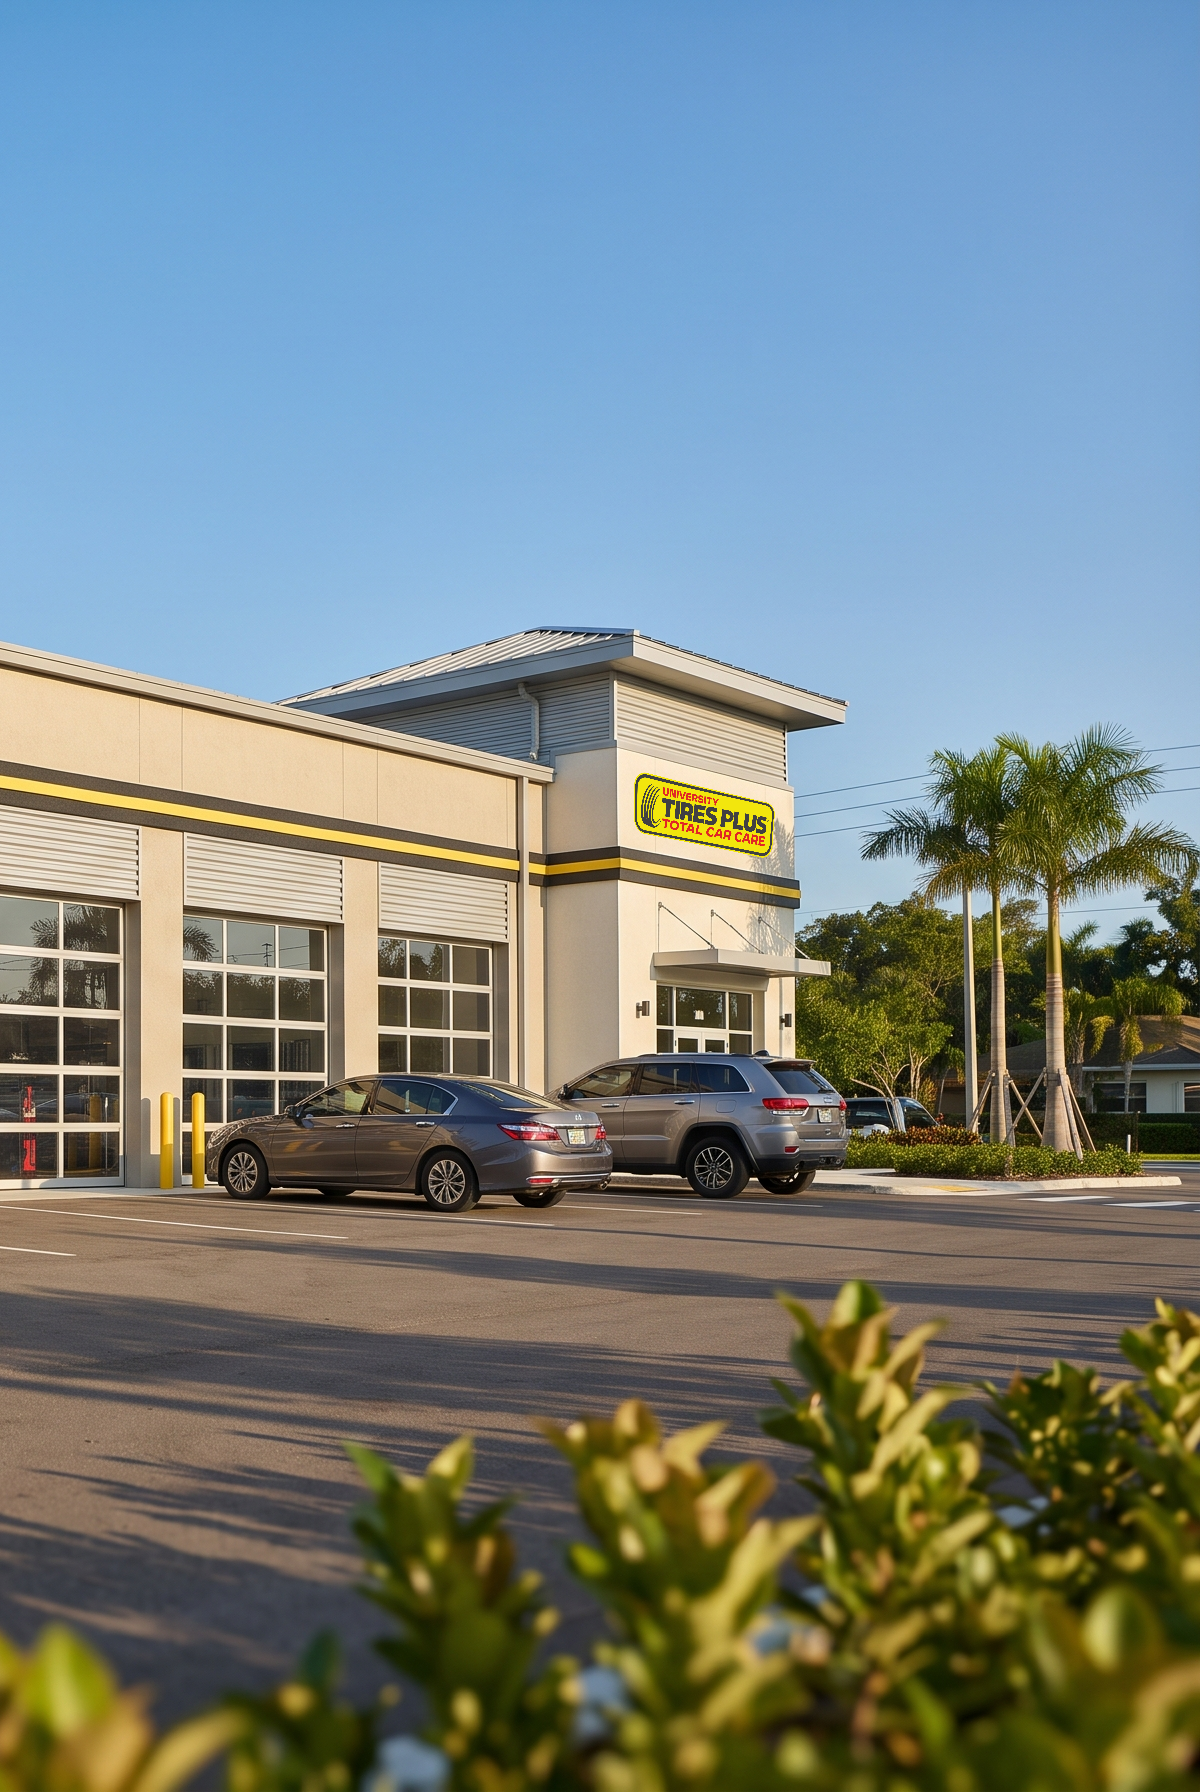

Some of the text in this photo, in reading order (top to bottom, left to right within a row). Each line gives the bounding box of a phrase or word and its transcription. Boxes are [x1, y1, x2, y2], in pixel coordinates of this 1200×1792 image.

[663, 787, 719, 806] UNIVERSITY
[662, 798, 767, 834] TIRES PLUS
[662, 818, 765, 846] TOTAL CAR CARE
